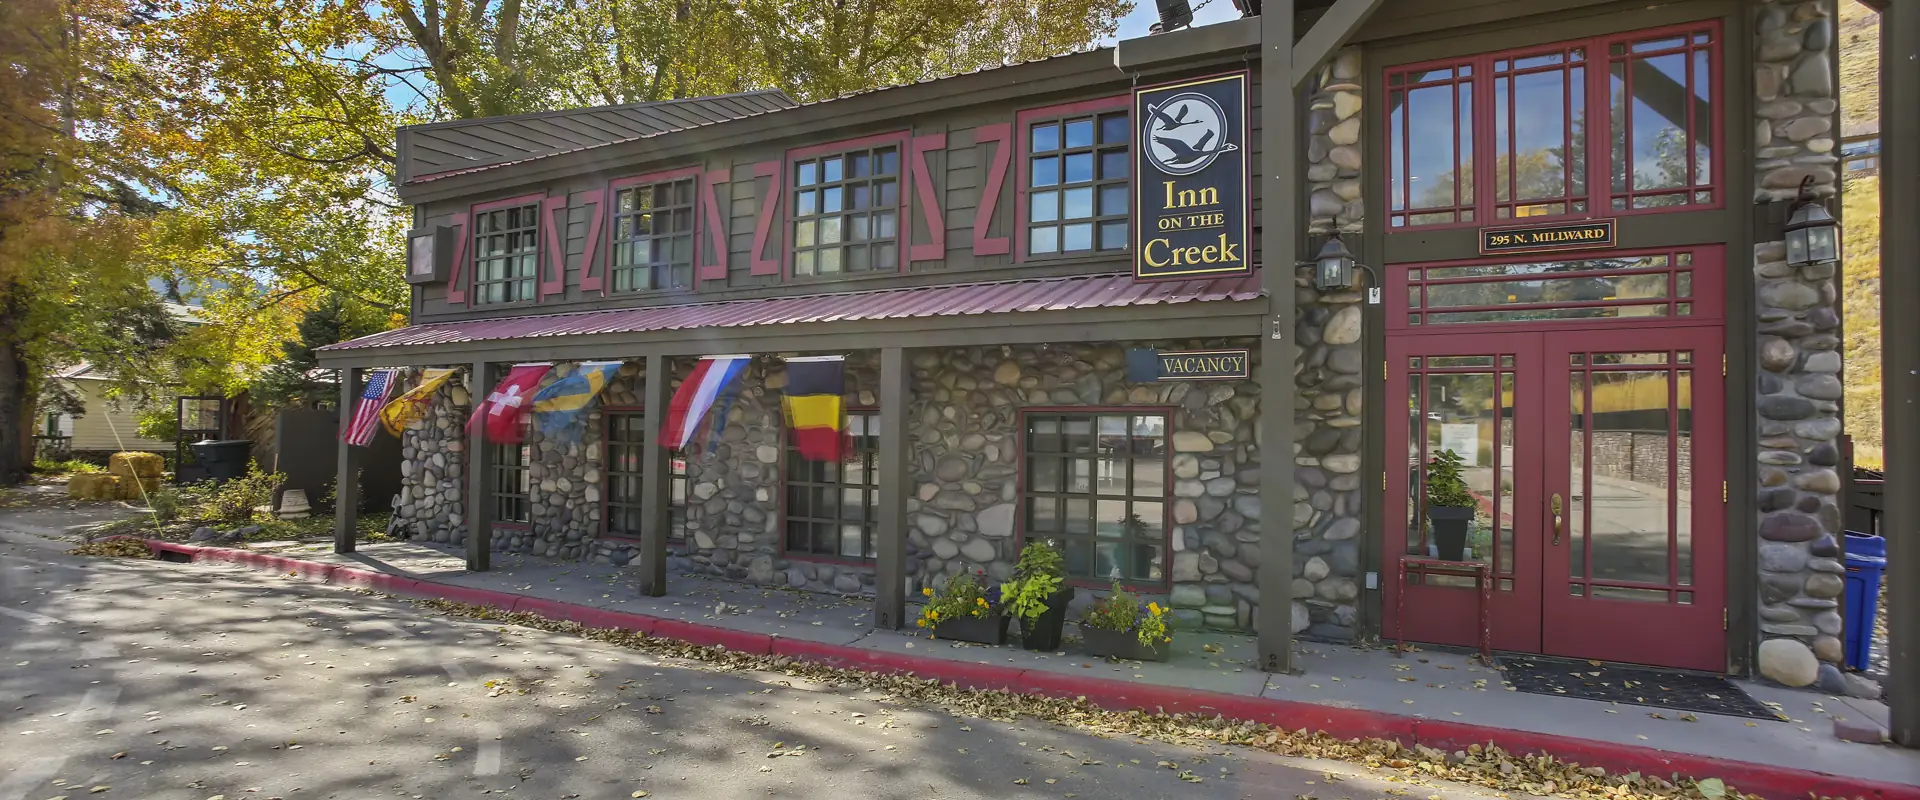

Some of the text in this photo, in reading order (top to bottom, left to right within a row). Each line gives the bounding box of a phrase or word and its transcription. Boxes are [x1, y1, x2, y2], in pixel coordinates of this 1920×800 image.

[1163, 181, 1219, 209] Inn
[1158, 213, 1224, 229] ON THE
[1490, 229, 1605, 245] 295 N. MILLWARD
[1144, 233, 1240, 267] Creek
[1163, 357, 1243, 373] VACANCY
